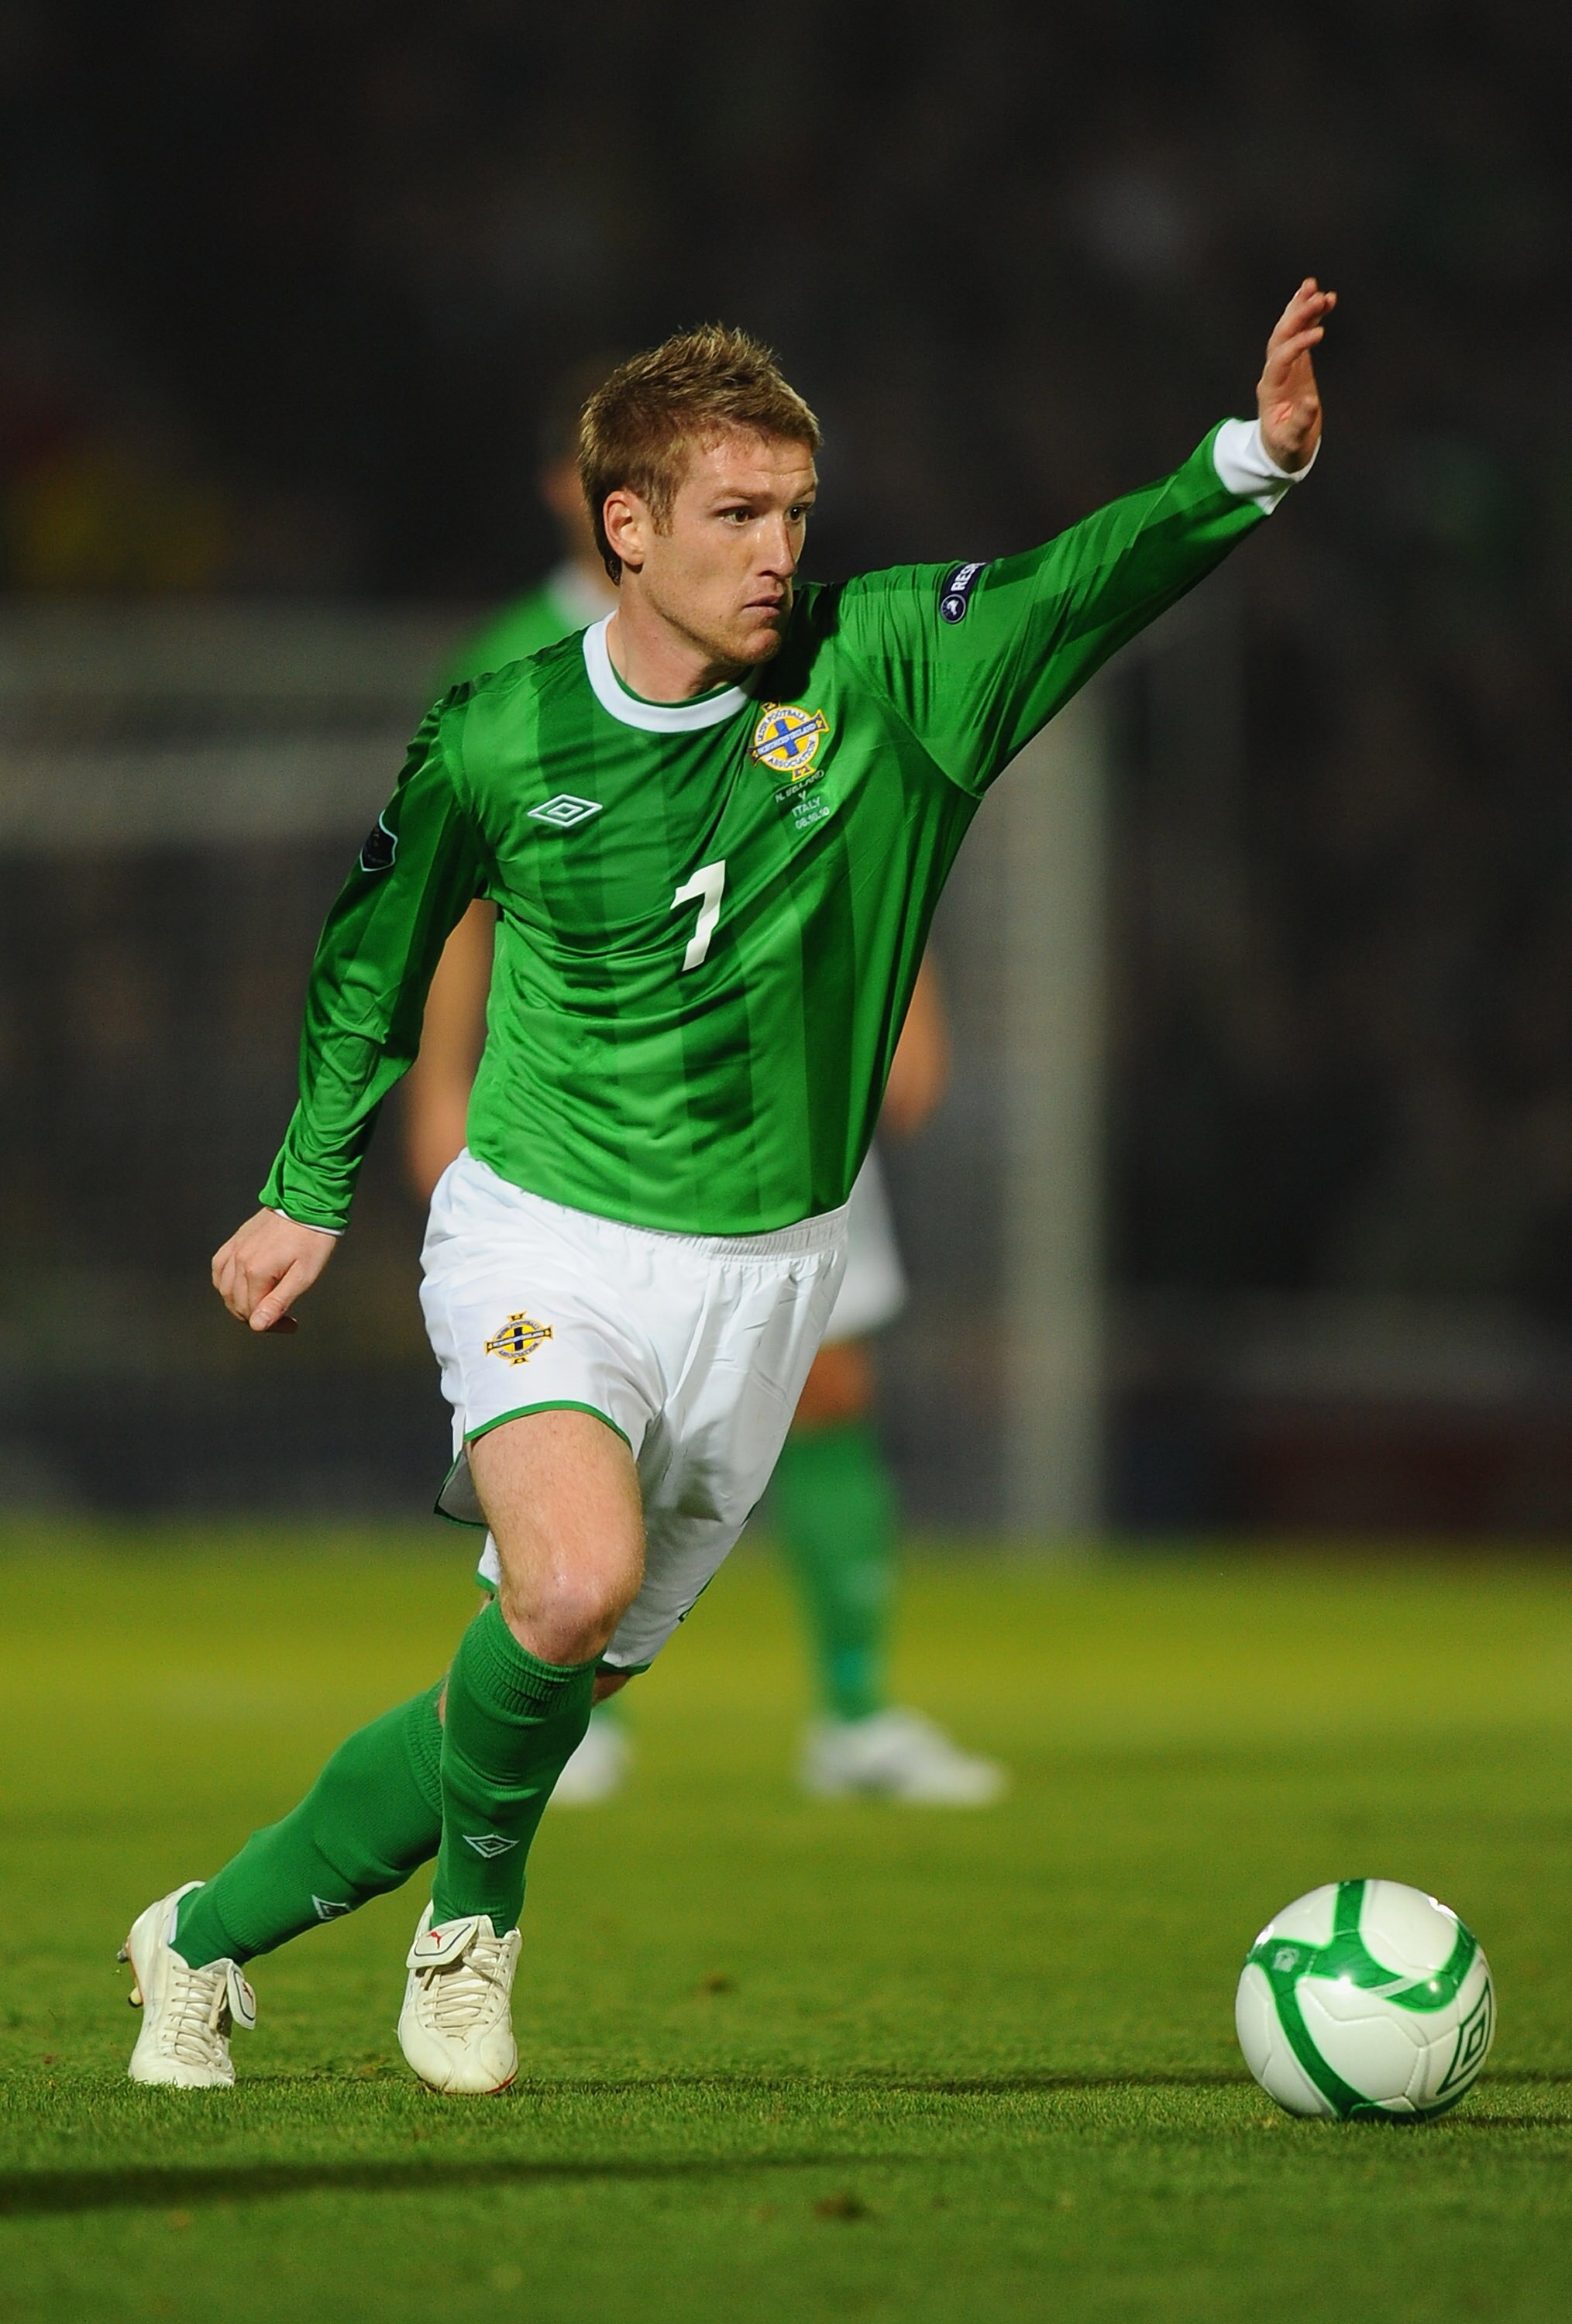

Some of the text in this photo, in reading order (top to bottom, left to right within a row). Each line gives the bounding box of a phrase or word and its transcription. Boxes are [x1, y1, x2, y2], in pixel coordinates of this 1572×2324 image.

[766, 709, 805, 721] FOOTBALL
[768, 740, 816, 768] ASSOCIATION
[791, 796, 820, 817] ITALY
[669, 859, 726, 972] 7
